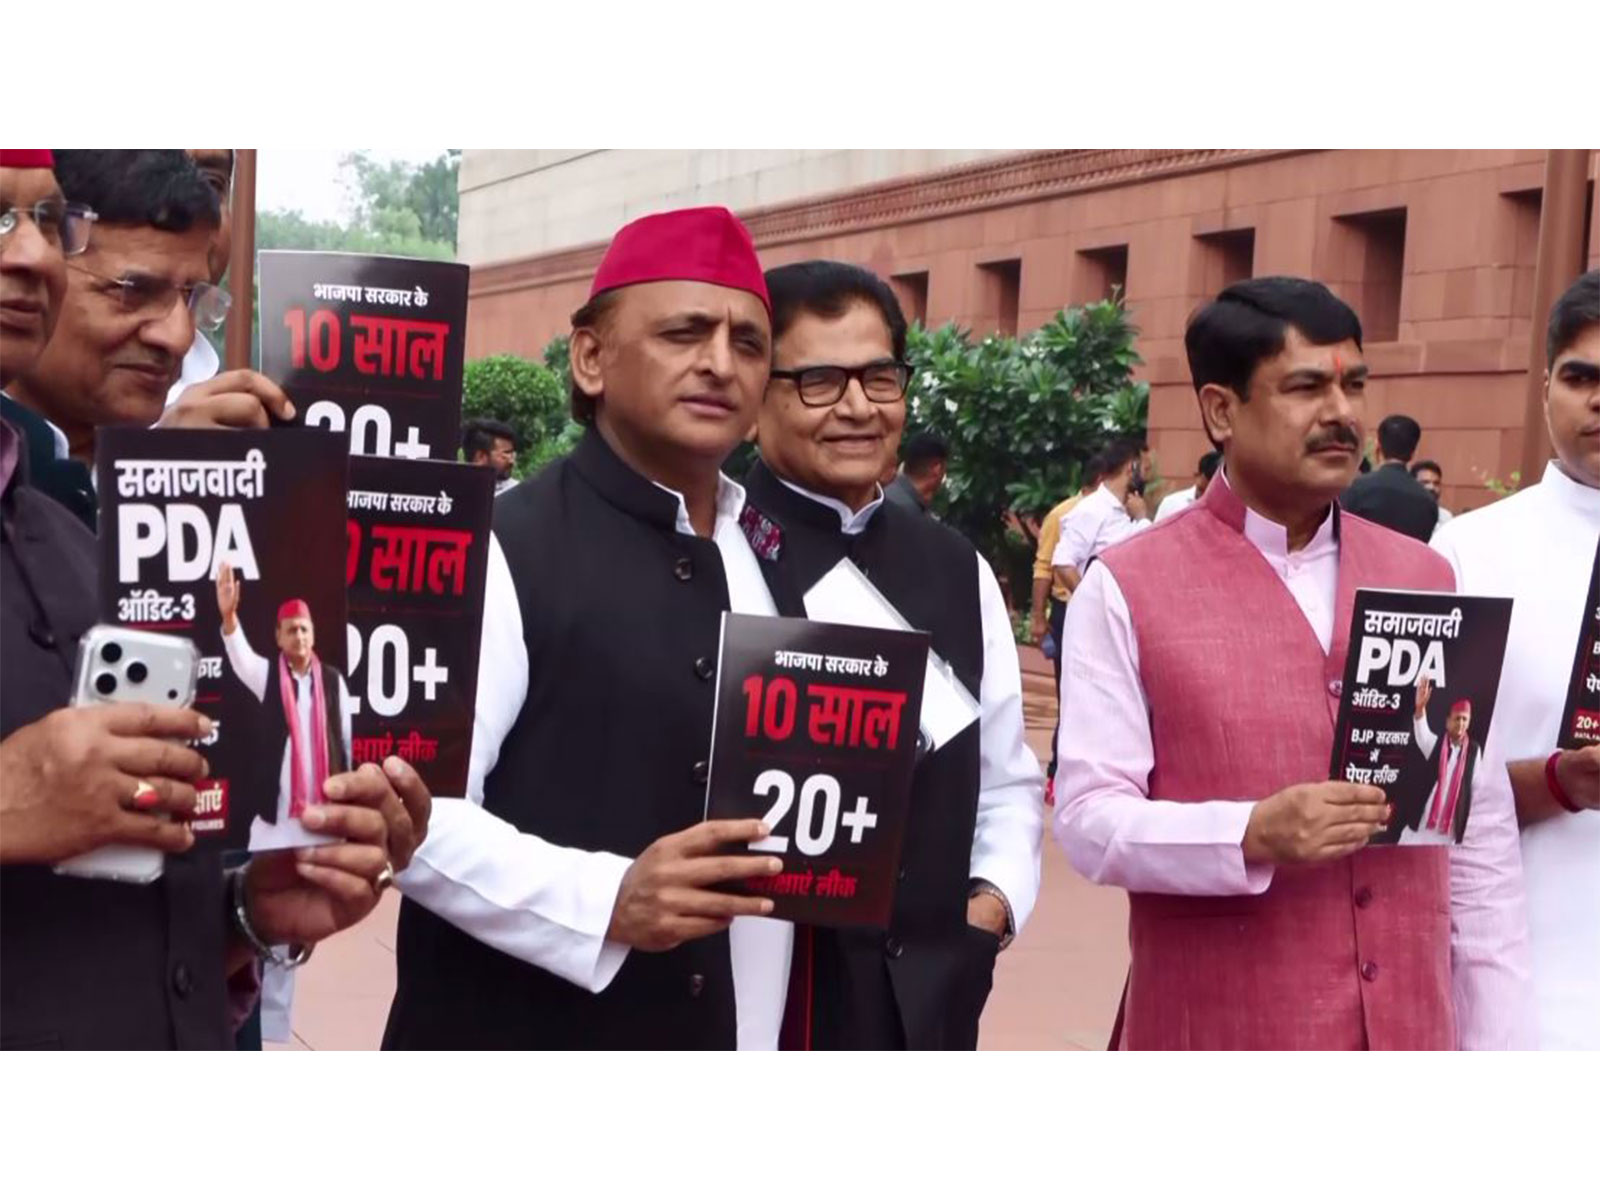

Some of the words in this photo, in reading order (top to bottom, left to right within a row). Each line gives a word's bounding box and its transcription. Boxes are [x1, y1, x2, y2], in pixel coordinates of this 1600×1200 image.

[313, 283, 362, 302] भाजपा
[364, 286, 412, 307] सरकार
[414, 286, 429, 307] के
[283, 308, 341, 372] 10
[349, 313, 450, 381] साल
[114, 448, 267, 498] समाजवादी
[346, 490, 388, 511] ाजपा
[390, 491, 435, 514] सरकार
[437, 491, 453, 515] के
[118, 503, 261, 583] PDA
[370, 524, 474, 595] साल
[117, 589, 196, 621] ऑडिट-3
[1363, 607, 1463, 639] समाजवादी
[774, 650, 823, 671] भाजपा
[825, 653, 873, 677] सरकार
[874, 655, 889, 677] के
[1355, 635, 1446, 689] PDA
[742, 674, 798, 741] 10
[807, 684, 908, 749] साल
[1351, 688, 1401, 710] ऑडिट-3
[1351, 727, 1374, 744] BJP
[1376, 730, 1411, 746] सरकार
[1345, 762, 1372, 785] पेपर
[1373, 763, 1400, 785] लीक
[748, 768, 878, 857] 20+
